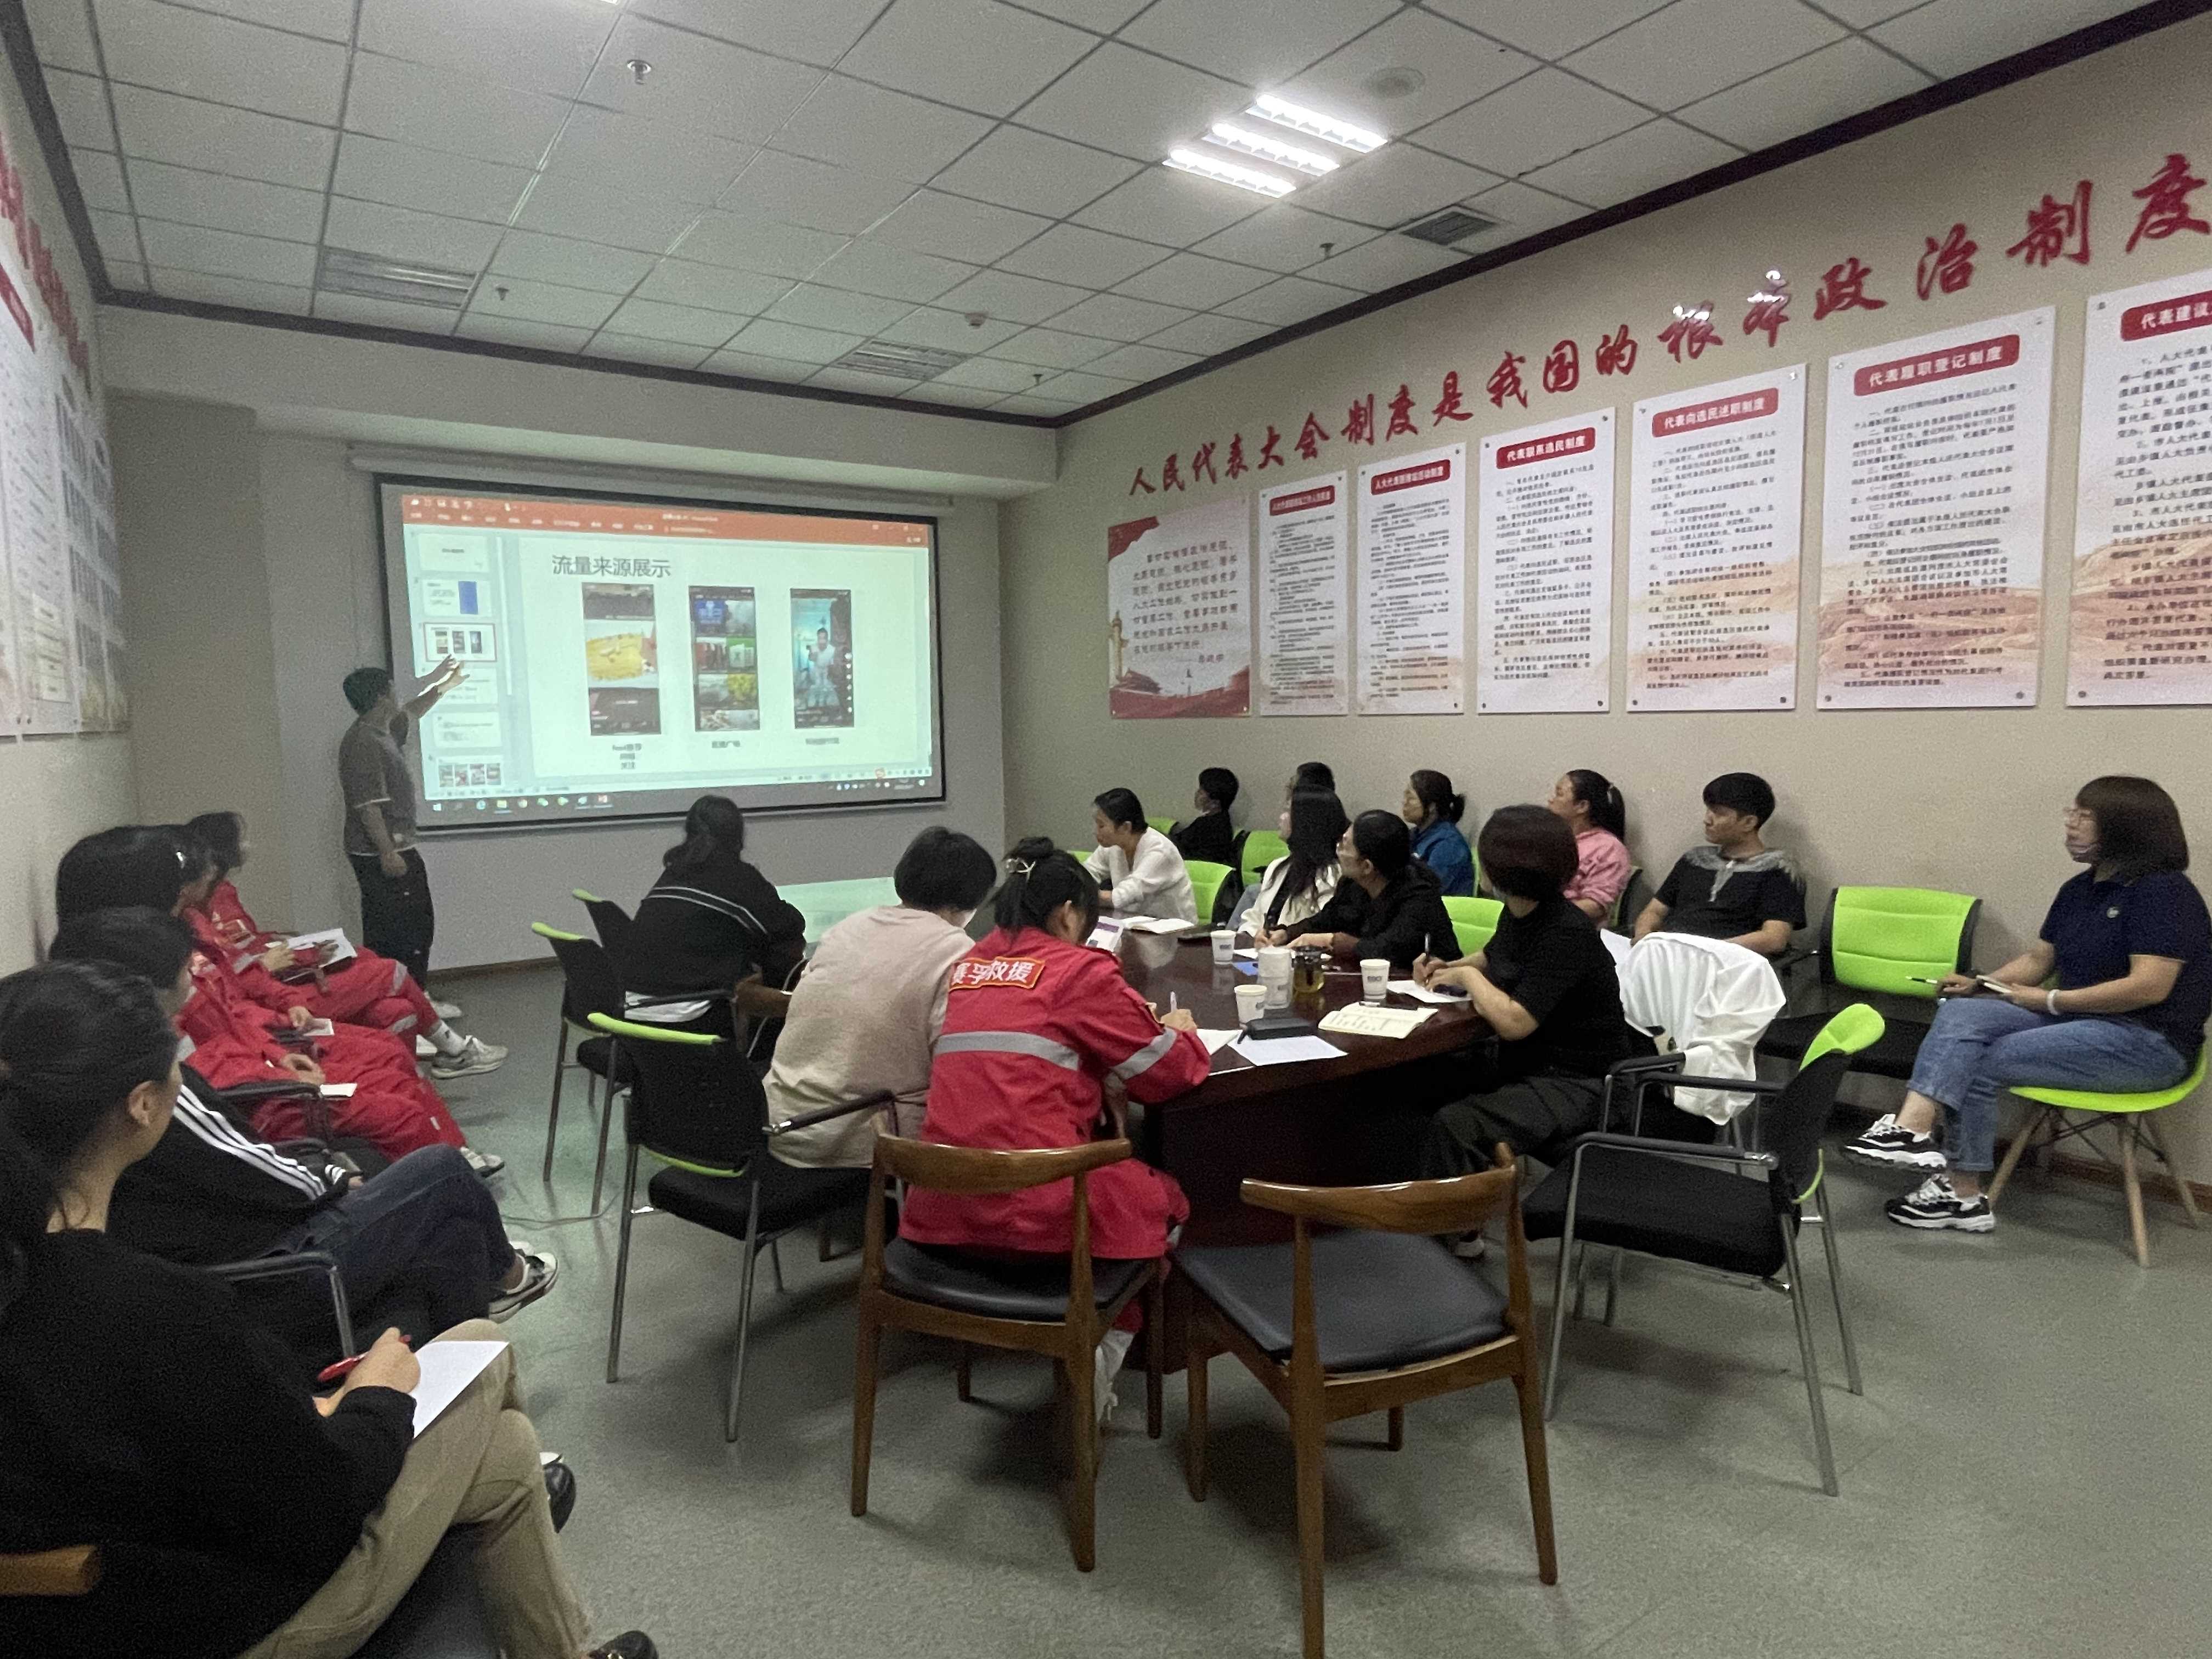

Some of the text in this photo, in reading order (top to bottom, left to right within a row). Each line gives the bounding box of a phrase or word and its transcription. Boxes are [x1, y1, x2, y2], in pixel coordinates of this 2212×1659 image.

[1130, 154, 2209, 496] 人民代表大会制度是我国的根本政治制度
[2141, 302, 2212, 329] 代表建议
[1869, 345, 2004, 388] 代表履职登记制度
[551, 554, 671, 578] 流量来源展示
